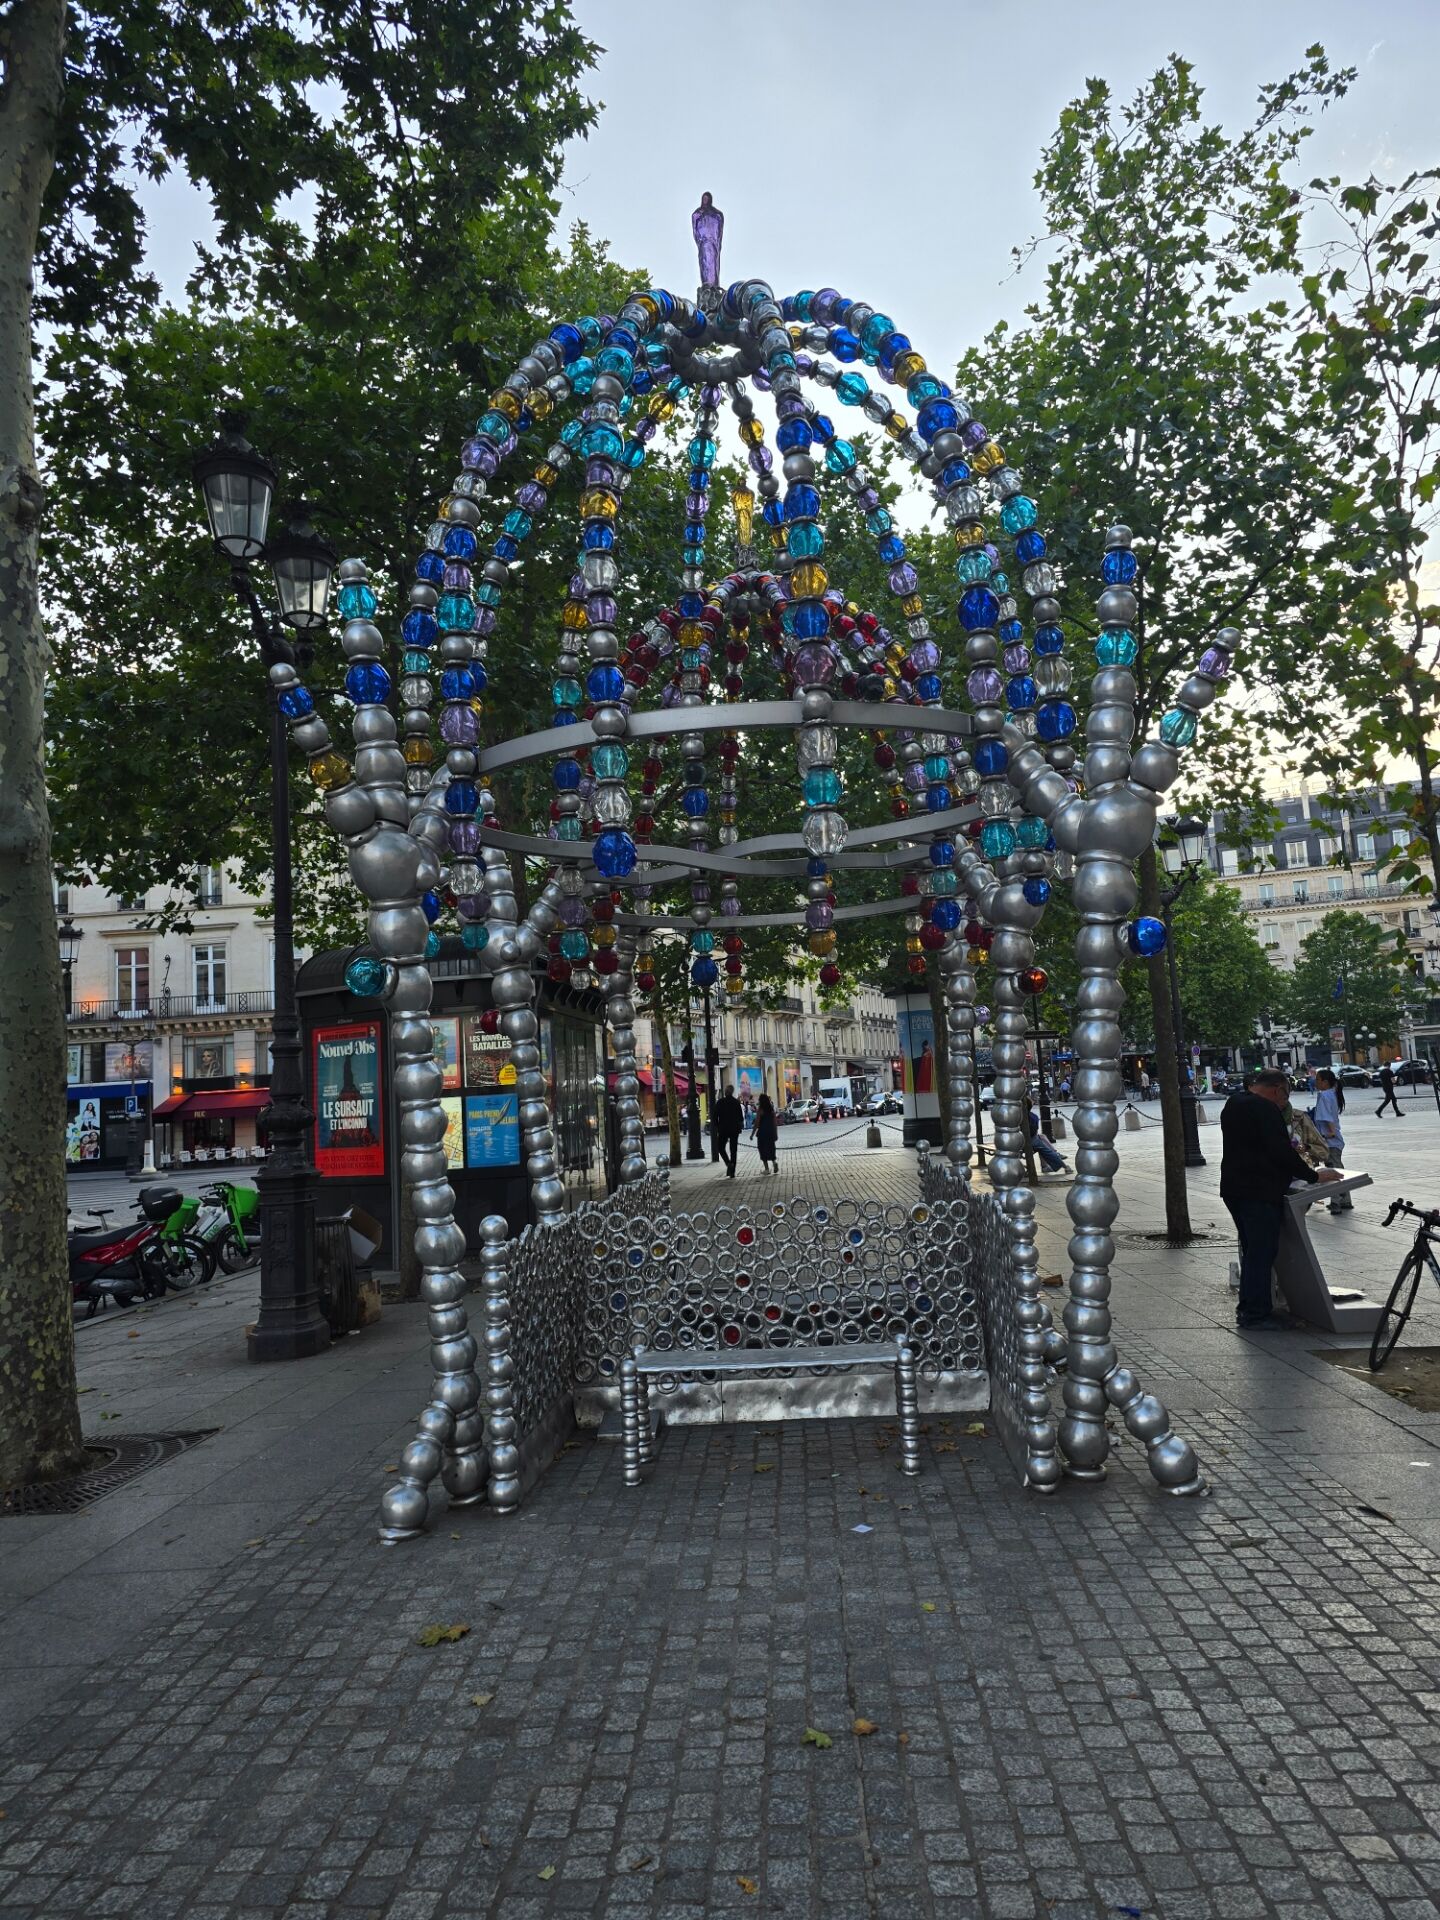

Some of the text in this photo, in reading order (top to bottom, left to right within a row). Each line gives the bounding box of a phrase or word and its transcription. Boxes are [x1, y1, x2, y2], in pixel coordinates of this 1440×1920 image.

[469, 1035, 481, 1043] LES
[320, 1040, 376, 1058] Nouvel Obs
[472, 1040, 512, 1051] BATAILLES
[128, 1099, 135, 1111] P
[323, 1099, 375, 1118] LE SURSAUT
[330, 1117, 368, 1130] ET L'INCONNU
